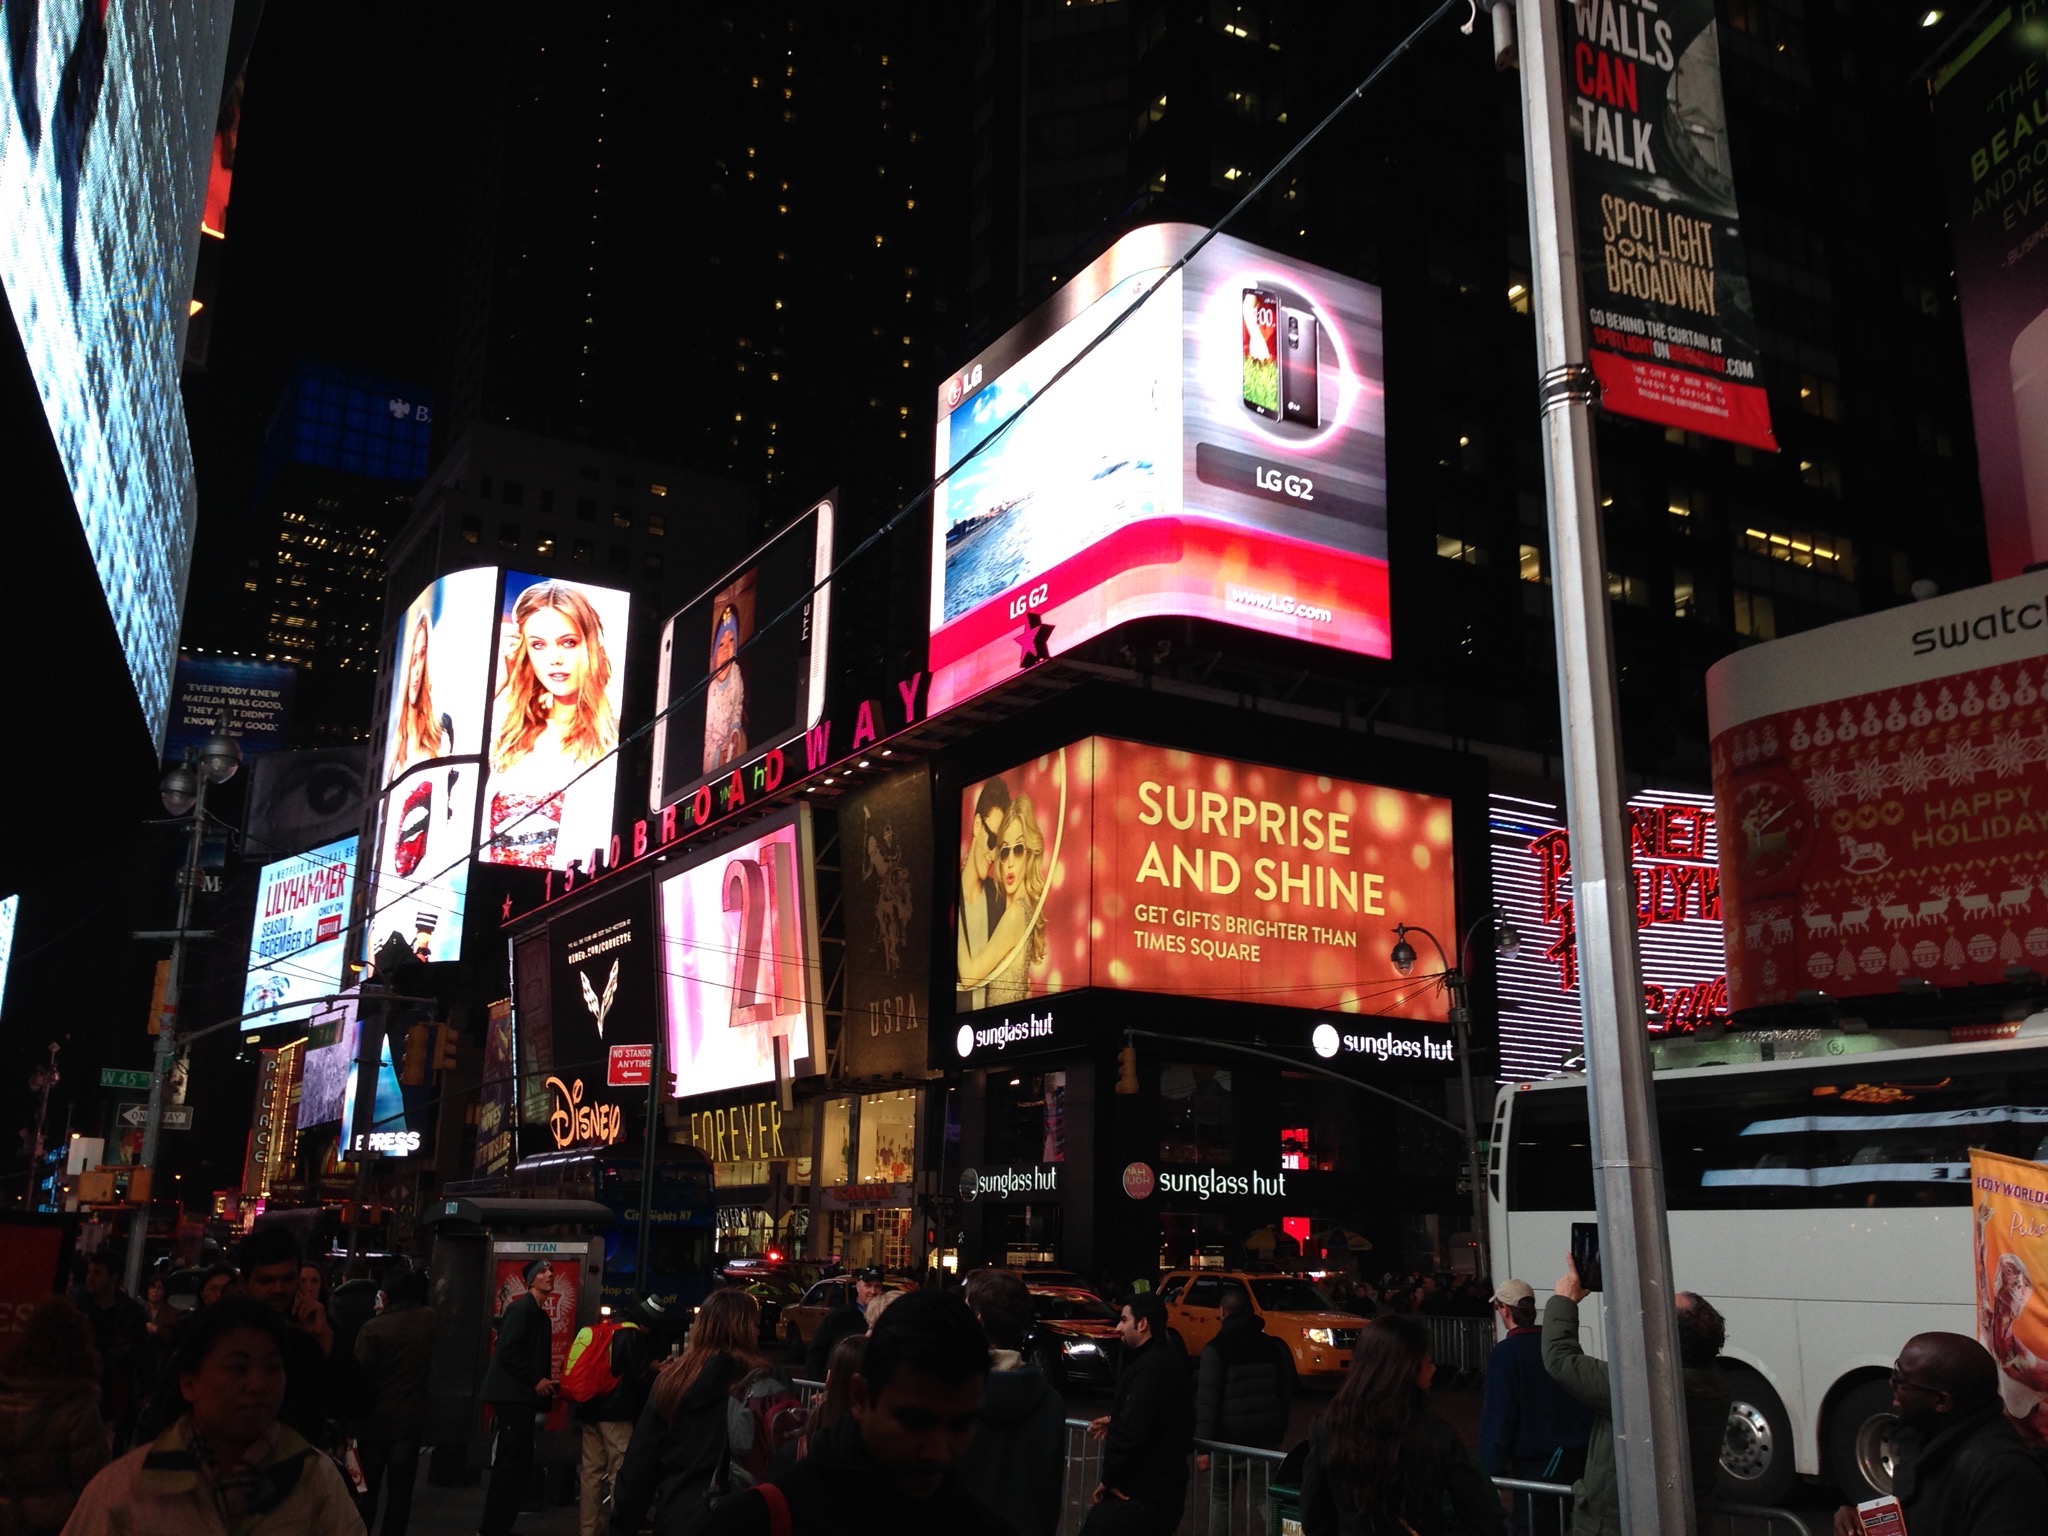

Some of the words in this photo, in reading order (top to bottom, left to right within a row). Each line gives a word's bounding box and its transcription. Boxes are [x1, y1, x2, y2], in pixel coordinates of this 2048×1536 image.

[1574, 0, 1674, 72] WALLS
[1575, 40, 1639, 114] CAN
[1576, 96, 1657, 175] TALK
[1600, 192, 1713, 270] SPOTLIGHT
[1617, 238, 1656, 264] ON
[1604, 243, 1716, 317] BROADWAY
[1589, 307, 1605, 327] GO
[1605, 311, 1646, 335] BEHIND
[1645, 320, 1667, 341] THE
[1667, 325, 1710, 350] CURTAIN
[1710, 336, 1723, 354] AT
[963, 363, 983, 395] LG
[1256, 466, 1282, 492] LG
[1284, 474, 1314, 501] G2
[1009, 595, 1027, 620] LG
[1028, 583, 1048, 609] G2
[1231, 588, 1333, 623] www.LG.com
[181, 694, 226, 705] MATILDA
[227, 697, 250, 707] WAS
[249, 688, 281, 698] KNEW
[183, 716, 217, 726] KNOW
[186, 705, 214, 715] THEY
[544, 840, 621, 902] 1540
[633, 671, 924, 860] BROADWAY
[1138, 781, 1351, 856] SURPRISE
[1924, 784, 2034, 824] HAPPY
[264, 862, 347, 918] LILYHAMMER
[1135, 840, 1242, 895] AND
[1253, 857, 1386, 917] SHINE
[318, 904, 335, 917] ONLY
[335, 901, 344, 913] ON
[1134, 903, 1169, 925] GET
[1172, 909, 1222, 932] GIFTS
[1225, 916, 1309, 943] BRIGHTER
[1311, 926, 1358, 948] THAN
[259, 930, 302, 959] DECEMBER
[303, 927, 313, 948] 13
[261, 916, 288, 939] SEASON
[289, 915, 295, 931] 2
[1134, 930, 1187, 954] TIMES
[1190, 937, 1261, 962] SQUARE
[869, 992, 919, 1038] USPA
[976, 1018, 1029, 1050] sunglass
[1030, 1012, 1054, 1038] hut
[612, 1049, 623, 1058] NO
[1343, 1031, 1421, 1061] sunglass
[1423, 1035, 1454, 1061] hut
[102, 1071, 116, 1084] W
[120, 1073, 137, 1087] 45
[617, 1059, 652, 1069] ANYTIME
[254, 1060, 277, 1164] PALACE
[355, 1131, 421, 1152] EPRESS
[691, 1101, 784, 1163] FOREVER
[979, 1167, 1033, 1199] sunglass
[1034, 1165, 1057, 1191] hut
[1159, 1168, 1249, 1200] sunglass
[1252, 1169, 1287, 1197] hut
[679, 1209, 693, 1221] NY
[2009, 1209, 2047, 1239] Pulse
[526, 1243, 557, 1252] TITAN
[601, 1285, 622, 1297] Hop
